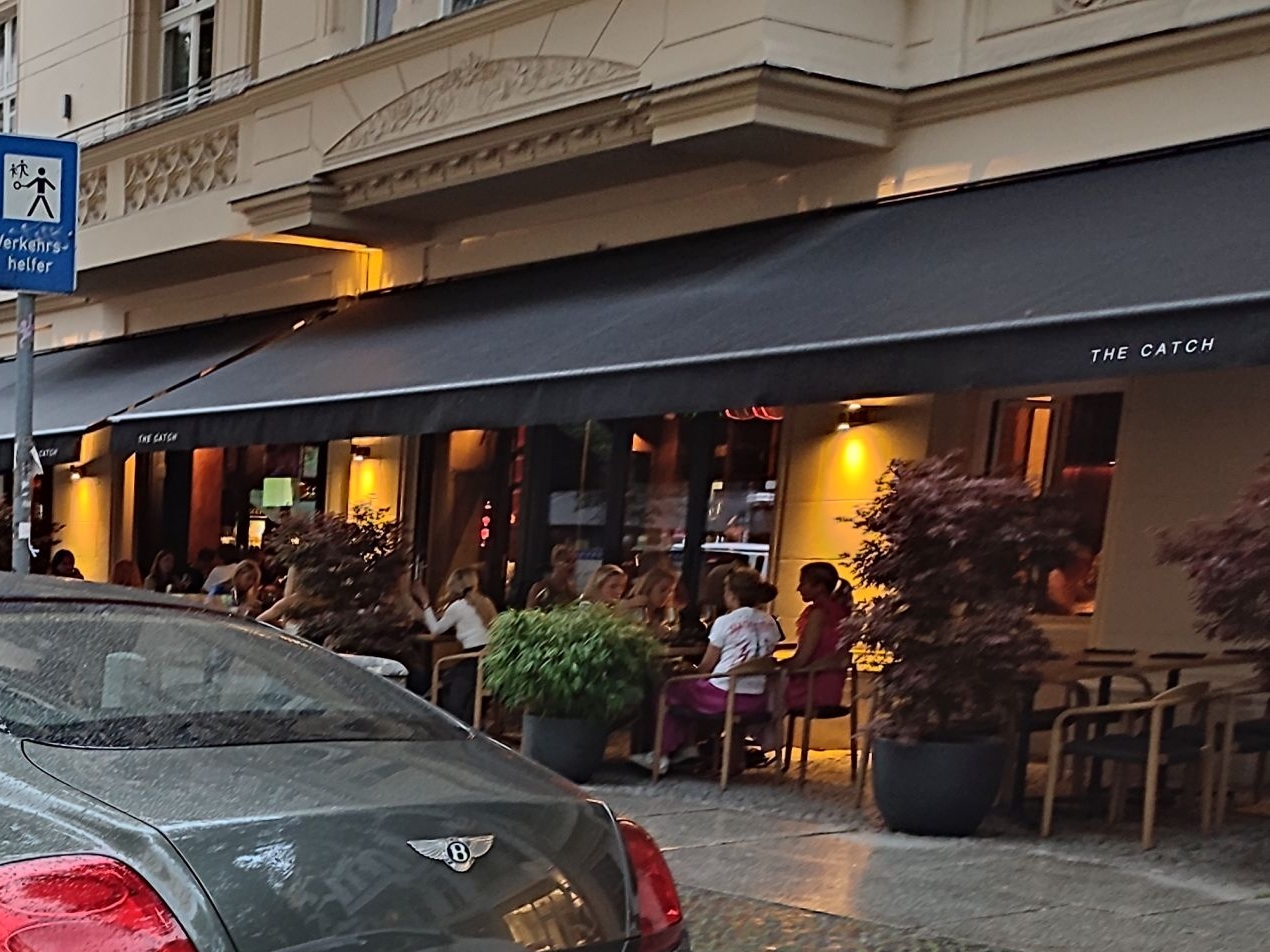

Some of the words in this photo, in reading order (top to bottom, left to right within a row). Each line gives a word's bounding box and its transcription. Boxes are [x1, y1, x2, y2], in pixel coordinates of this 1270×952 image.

[8, 255, 54, 273] helfer
[1091, 346, 1129, 363] THE
[1140, 337, 1215, 357] CATCH
[138, 434, 151, 443] THE
[153, 432, 179, 443] CATCH
